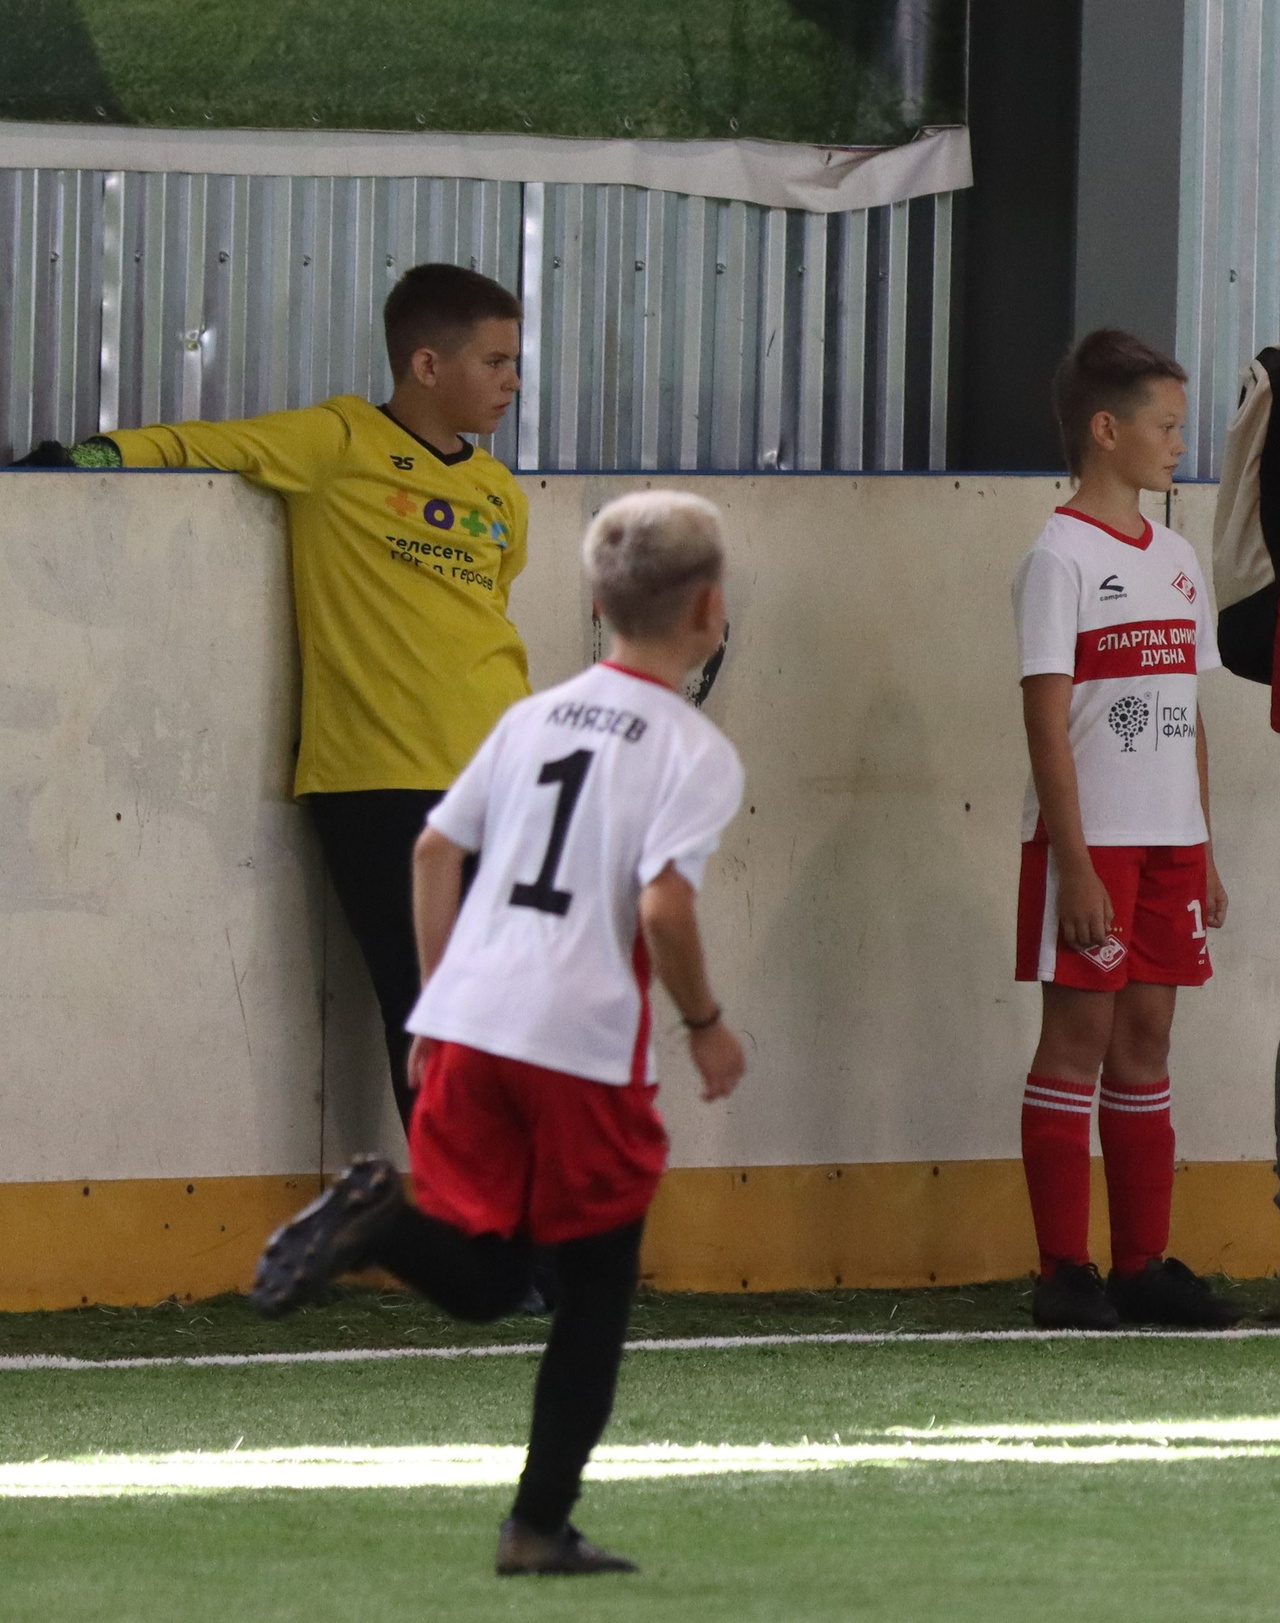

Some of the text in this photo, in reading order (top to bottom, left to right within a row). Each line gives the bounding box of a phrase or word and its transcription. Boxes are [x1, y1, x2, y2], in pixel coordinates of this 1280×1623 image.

[1098, 629, 1167, 651] СПАРТАК
[1141, 648, 1186, 667] ДУБНА
[1162, 706, 1188, 721] ПСК
[1162, 723, 1196, 738] ФАРМ
[509, 748, 595, 916] 1
